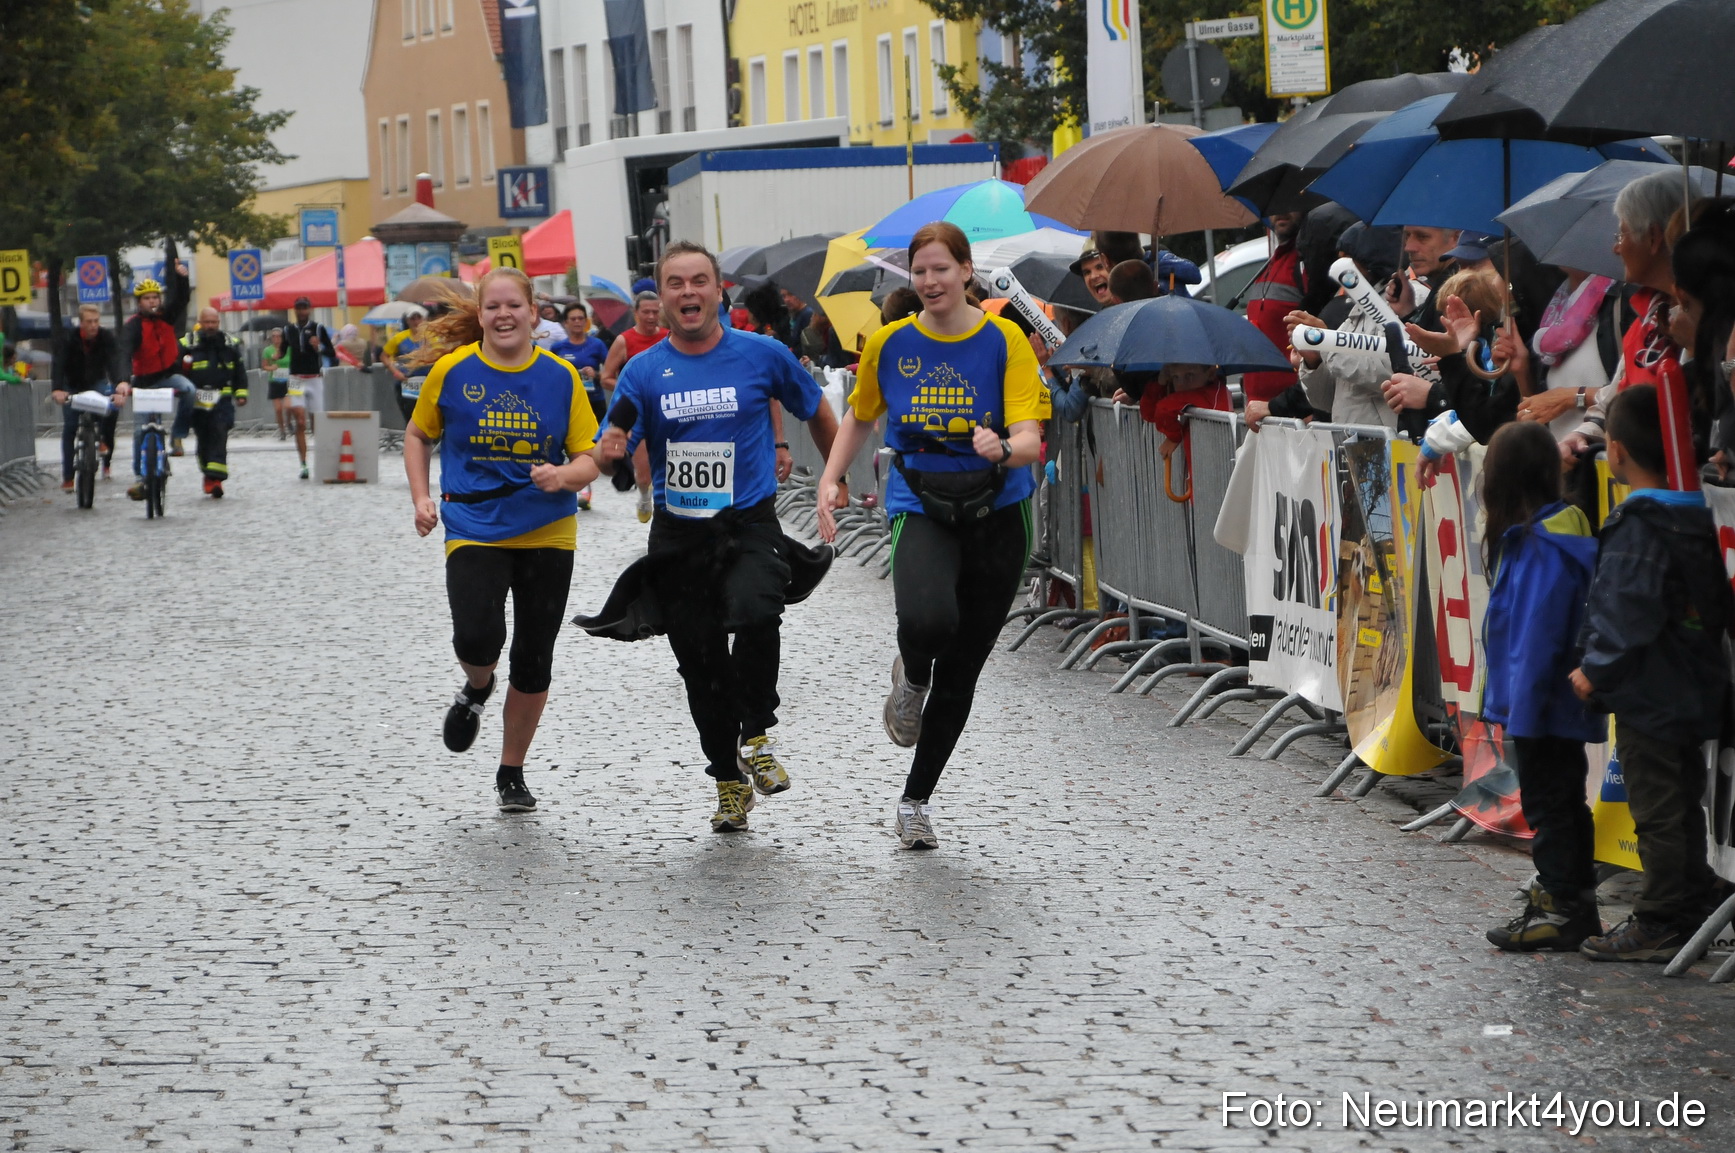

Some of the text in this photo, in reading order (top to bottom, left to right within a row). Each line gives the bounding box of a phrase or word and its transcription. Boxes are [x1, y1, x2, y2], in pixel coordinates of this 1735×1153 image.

[789, 2, 819, 36] HOTEL
[1200, 22, 1254, 35] Ulmer Gasse
[1277, 33, 1315, 42] Marktplatz
[492, 239, 519, 249] Block
[2, 267, 20, 293] D
[81, 287, 106, 299] TAXI
[233, 284, 260, 296] TAXI
[1335, 331, 1380, 352] BMW
[660, 387, 737, 411] HUBER
[1039, 391, 1051, 399] PA
[677, 403, 735, 416] TECHNOLOGY
[911, 406, 956, 414] 21.September
[479, 429, 521, 437] 21.September
[682, 450, 720, 458] Neumarkt
[667, 461, 727, 489] 2860
[680, 496, 709, 507] Andre
